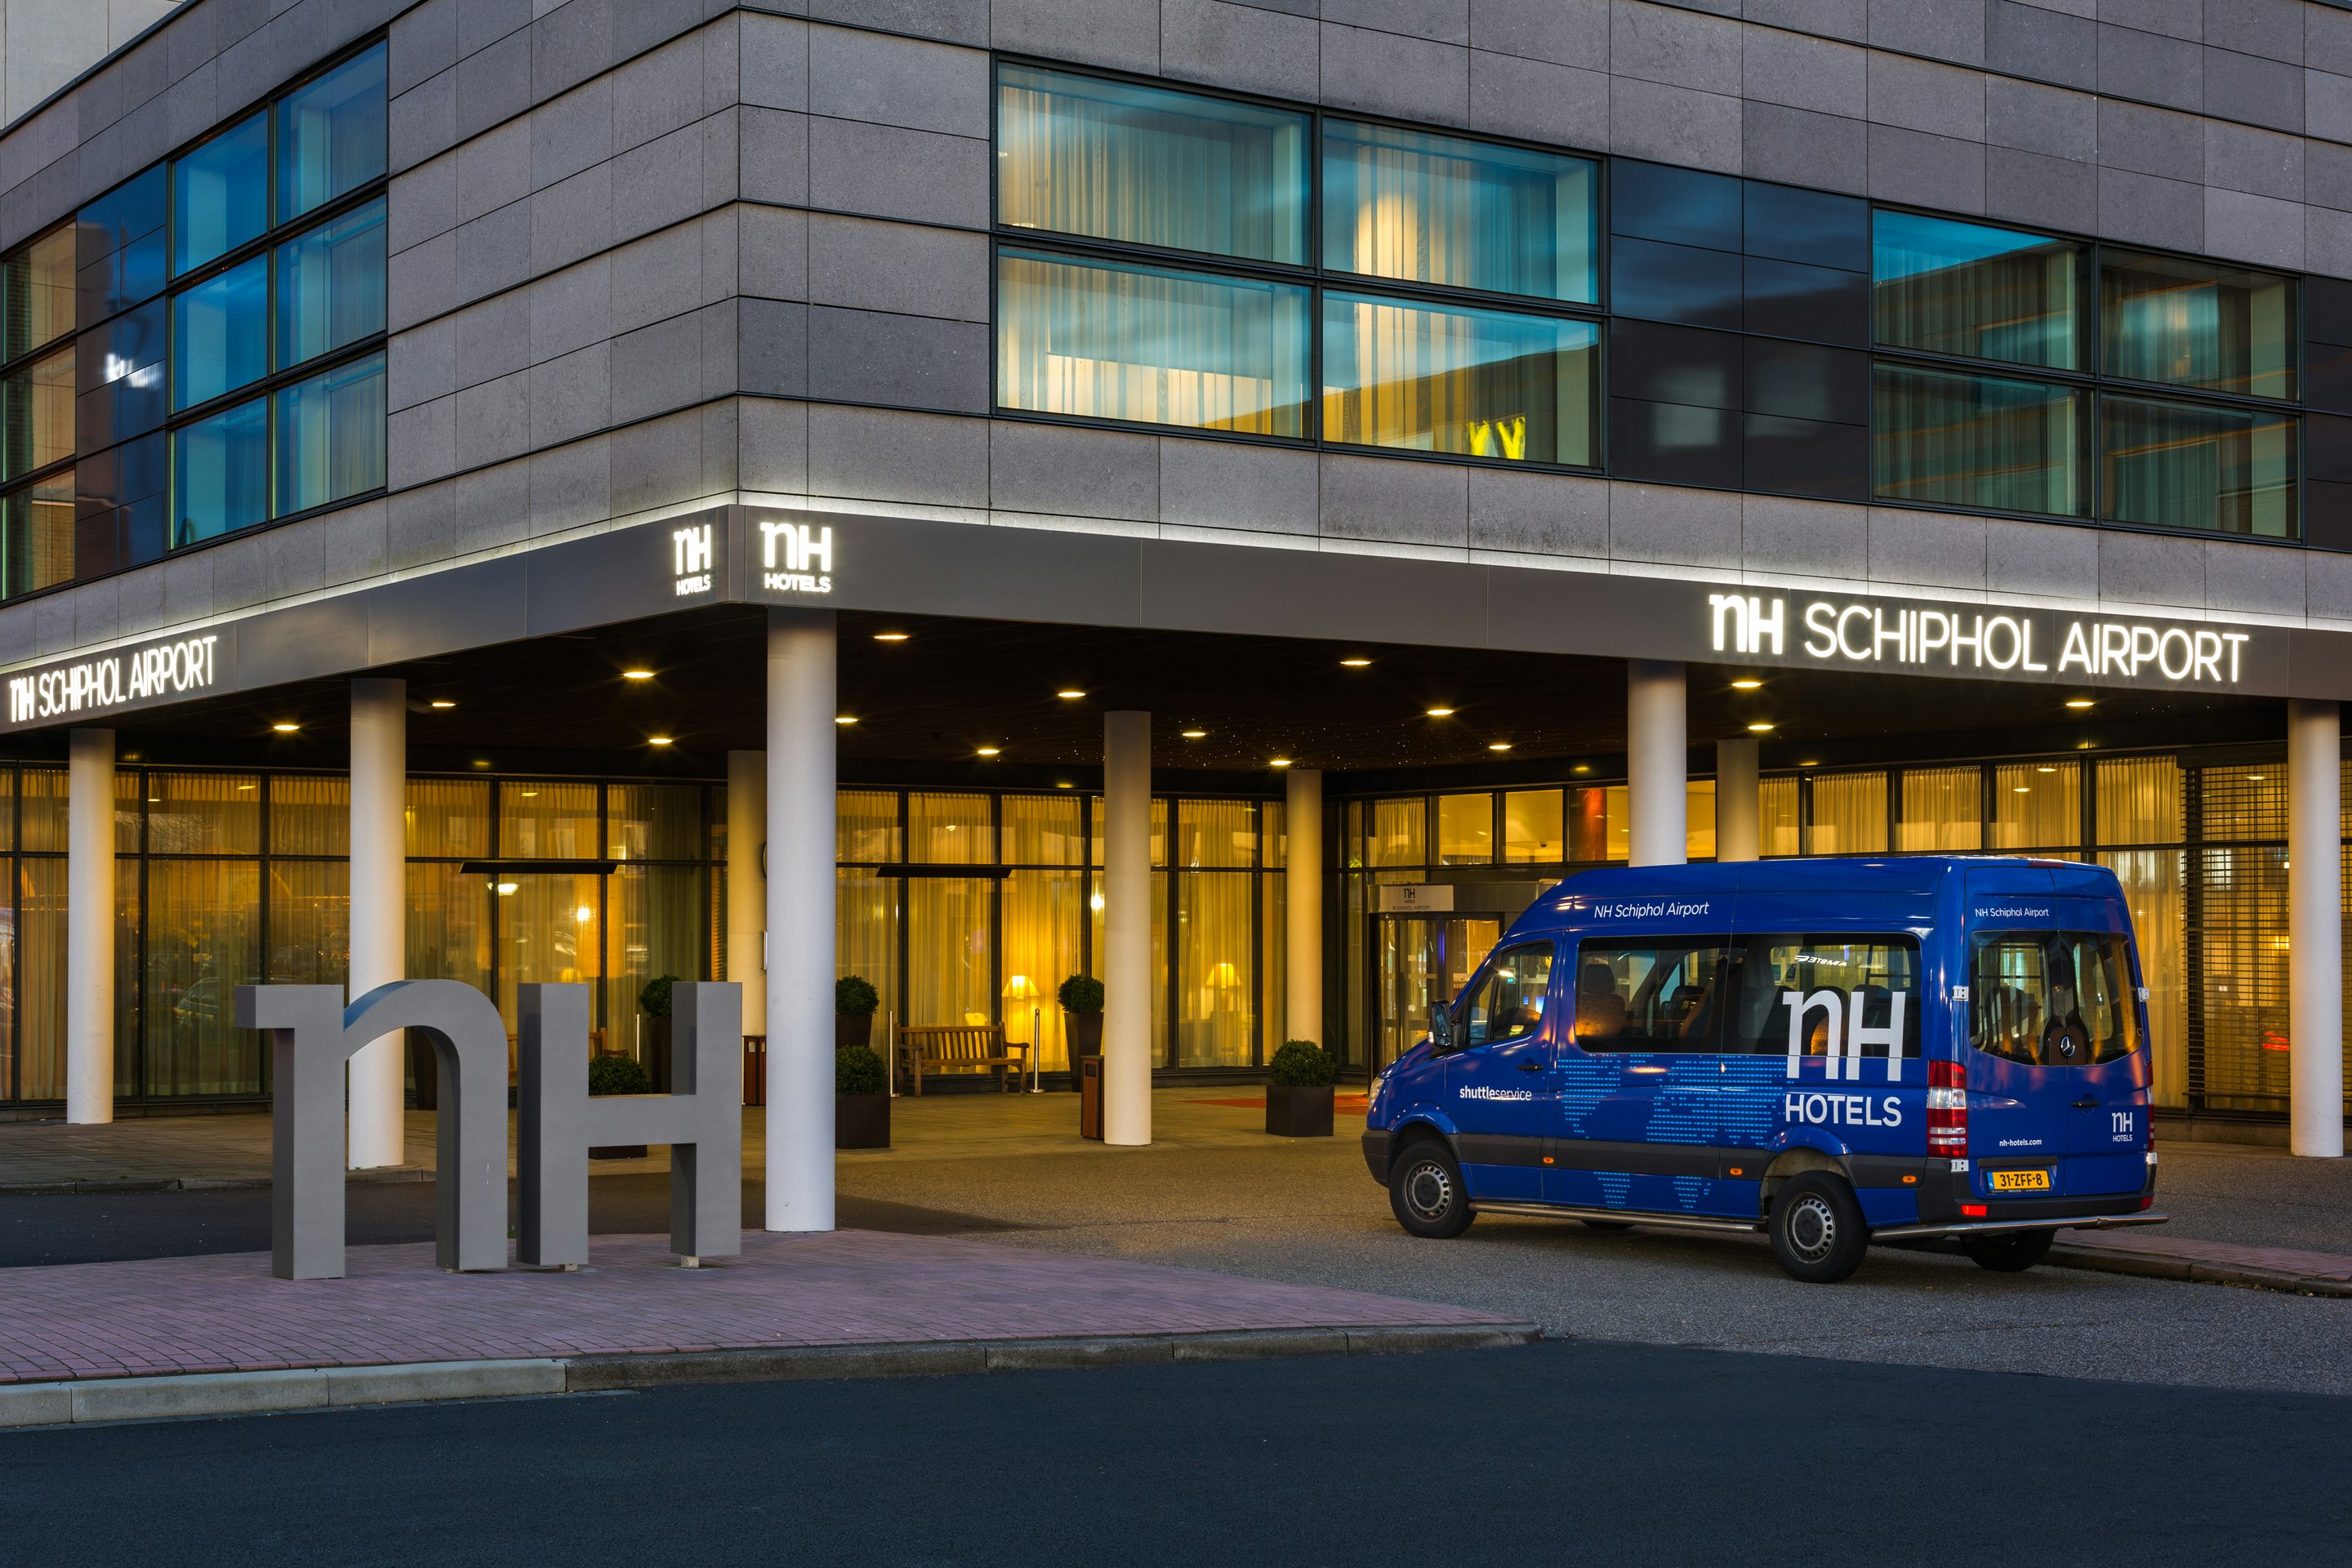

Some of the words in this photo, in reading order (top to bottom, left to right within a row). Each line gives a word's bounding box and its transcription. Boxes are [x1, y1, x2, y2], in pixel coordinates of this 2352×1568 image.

[676, 574, 710, 595] HOTELS
[764, 573, 831, 593] HOTELS
[1805, 602, 2047, 673] SCHIPHOL
[2058, 621, 2249, 683] AIRPORT
[39, 657, 126, 717] SCHIPHOL
[129, 636, 217, 699] AIRPORT
[1594, 906, 1613, 919] NH
[1615, 902, 1664, 920] Schiphol
[1666, 902, 1710, 918] Airport
[1975, 908, 1988, 916] NH
[1990, 907, 2022, 918] Schiphol
[2025, 907, 2049, 917] Airport
[1459, 1085, 1532, 1101] shuttleservice
[1785, 1094, 1902, 1127] HOTELS
[1999, 1174, 2043, 1187] 31-ZFF-8
